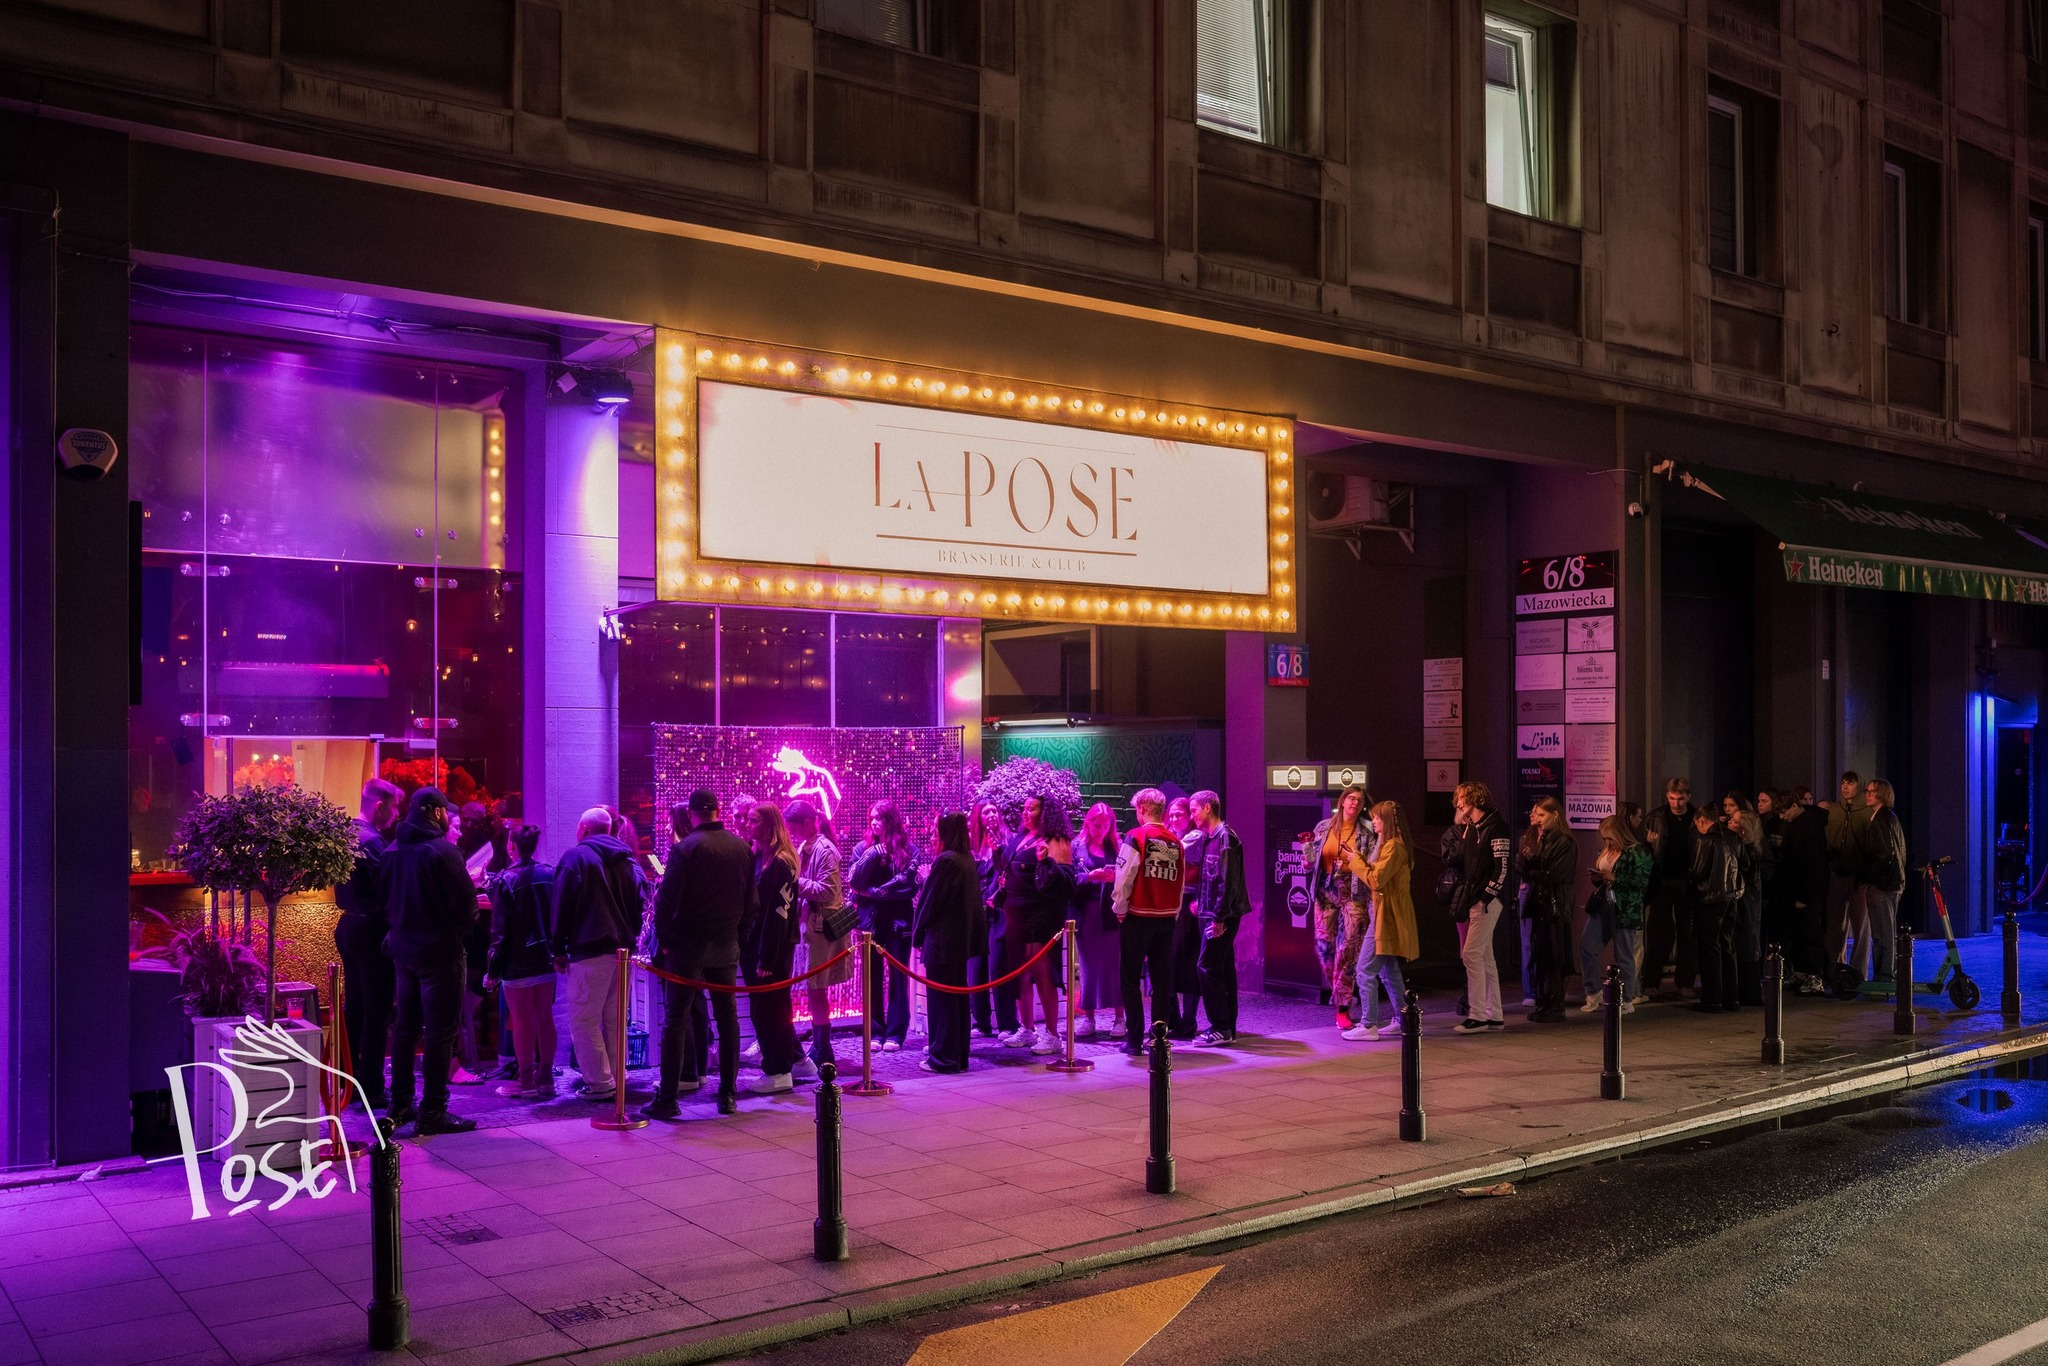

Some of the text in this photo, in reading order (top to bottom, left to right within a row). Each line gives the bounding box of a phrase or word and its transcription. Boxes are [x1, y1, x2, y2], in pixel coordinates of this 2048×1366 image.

[874, 441, 1138, 541] LA POSE
[937, 549, 1087, 572] BRASSERIE & CLUB
[1808, 555, 1884, 587] Heineken
[1543, 556, 1585, 590] 6/8
[1523, 592, 1606, 611] Mazowiecka
[1277, 653, 1302, 678] 6/8
[1521, 731, 1560, 751] Link
[1568, 803, 1613, 813] MAZOWIA
[1144, 865, 1178, 882] RHU
